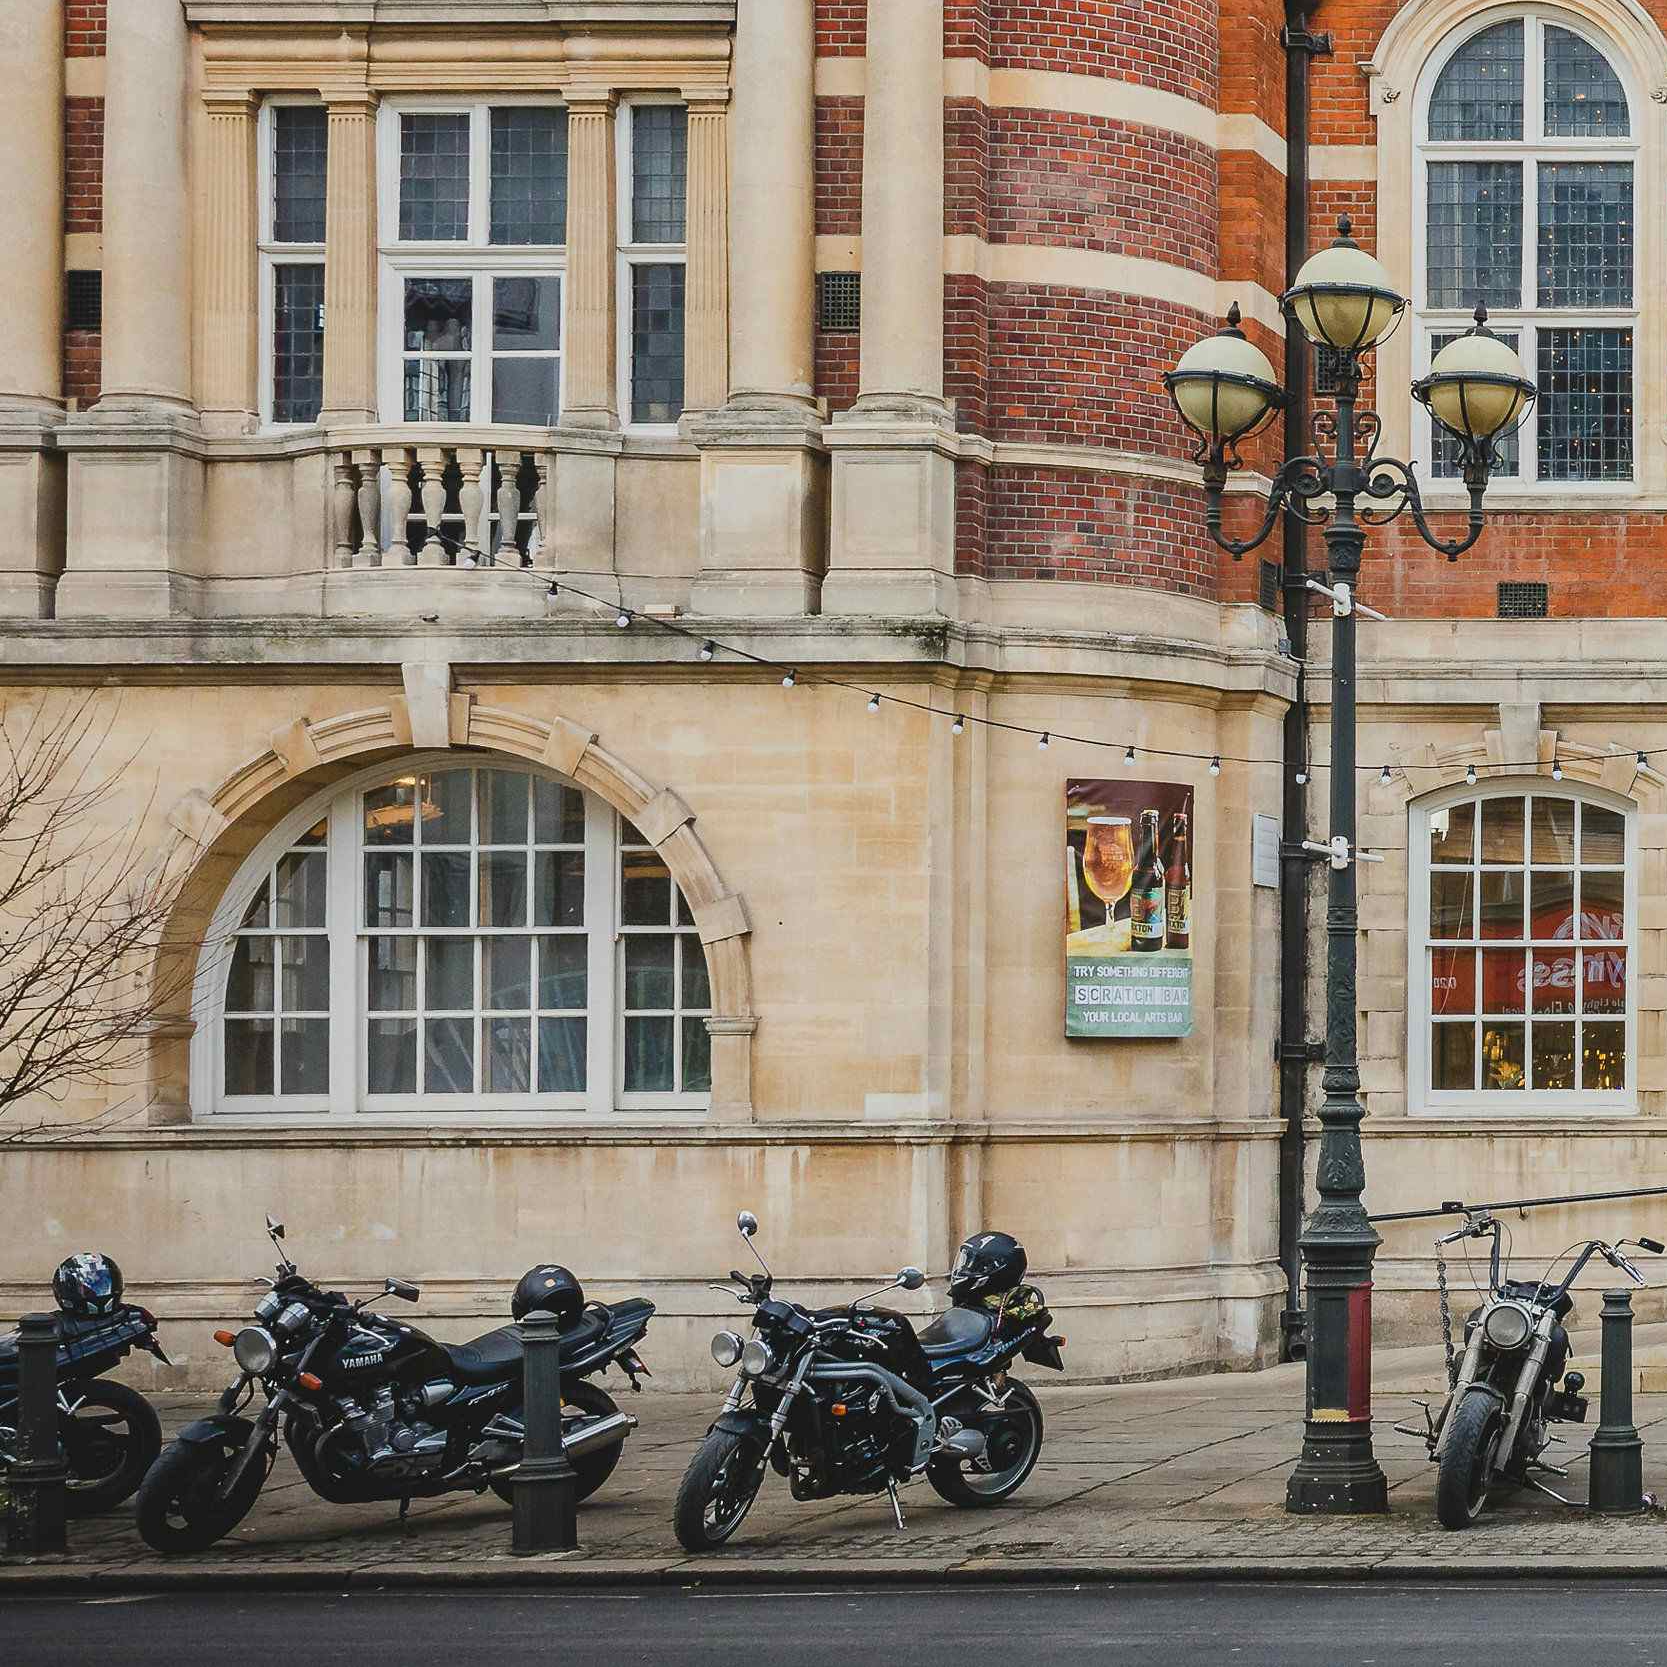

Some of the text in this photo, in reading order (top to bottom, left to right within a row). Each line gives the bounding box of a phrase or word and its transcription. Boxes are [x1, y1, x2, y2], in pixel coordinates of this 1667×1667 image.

[1073, 965, 1095, 977] TRY
[1097, 965, 1148, 977] SOMETHING
[1078, 987, 1189, 1002] SCRATCH BAR
[1083, 1011, 1184, 1023] YOUR LOCAL ARTS BAR
[342, 1353, 383, 1369] YAMAHA
